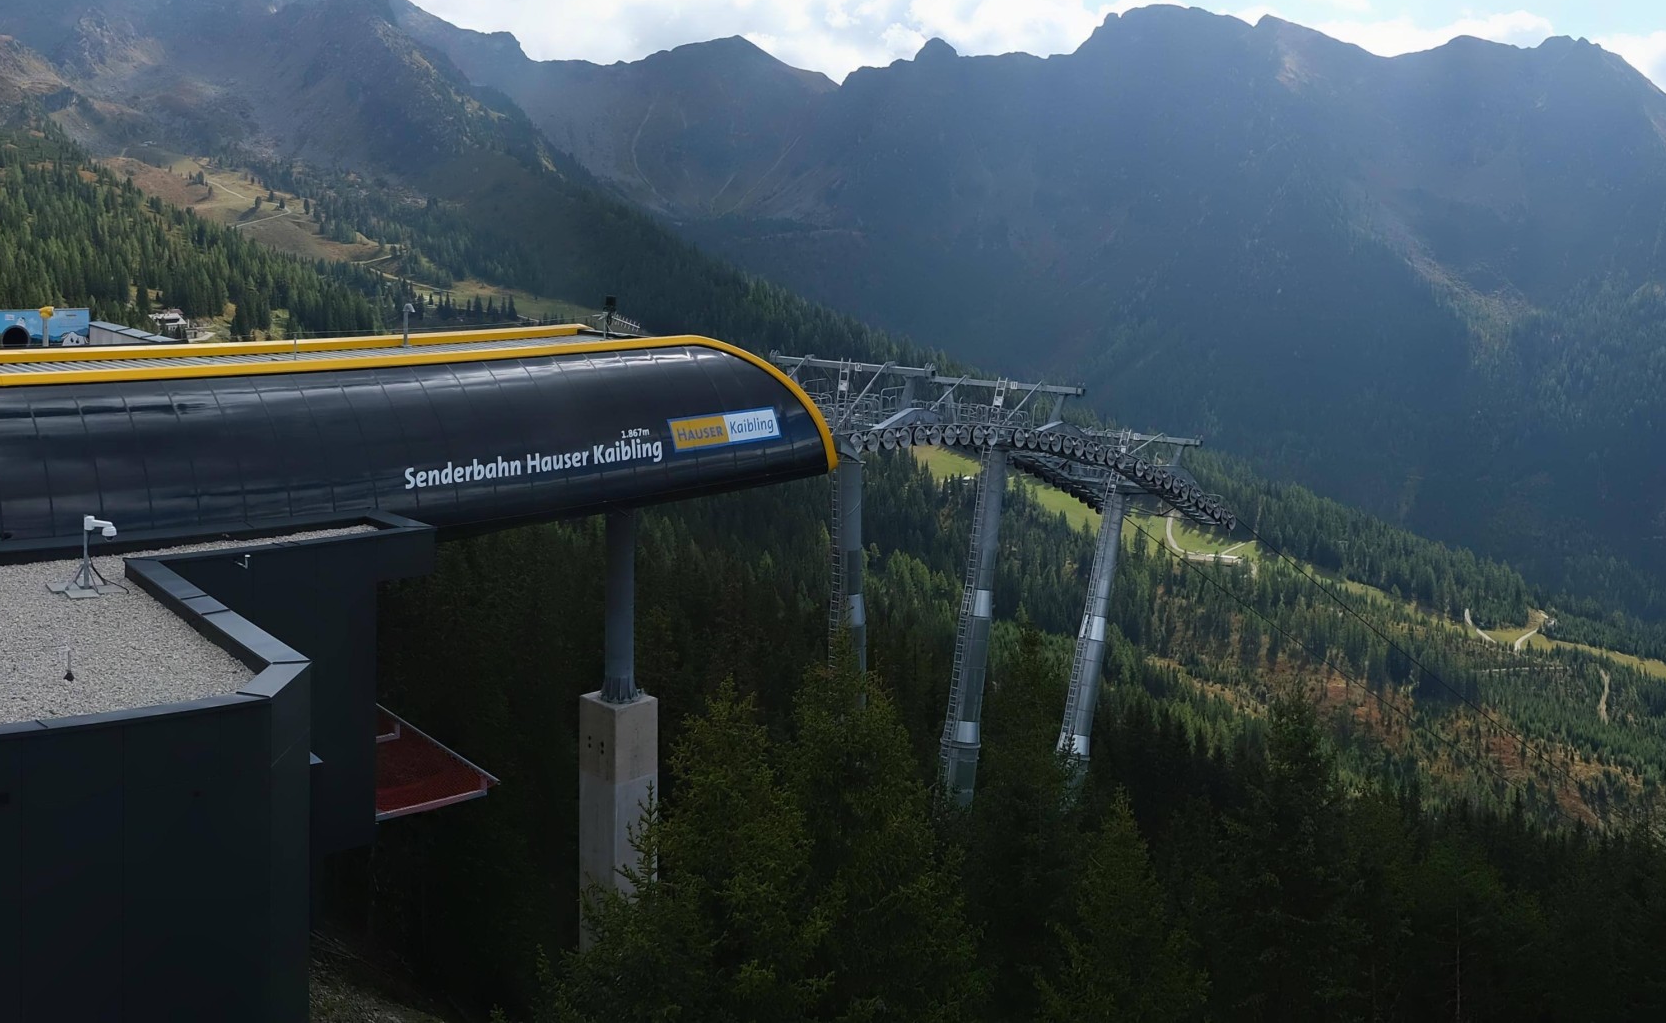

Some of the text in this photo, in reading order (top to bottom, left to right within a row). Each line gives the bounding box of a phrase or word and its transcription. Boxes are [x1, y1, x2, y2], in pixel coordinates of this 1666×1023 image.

[620, 428, 650, 439] 1.867m
[677, 418, 774, 442] HAUSER Kaibling
[404, 437, 663, 490] Senderbahn Hauser Kaibling
